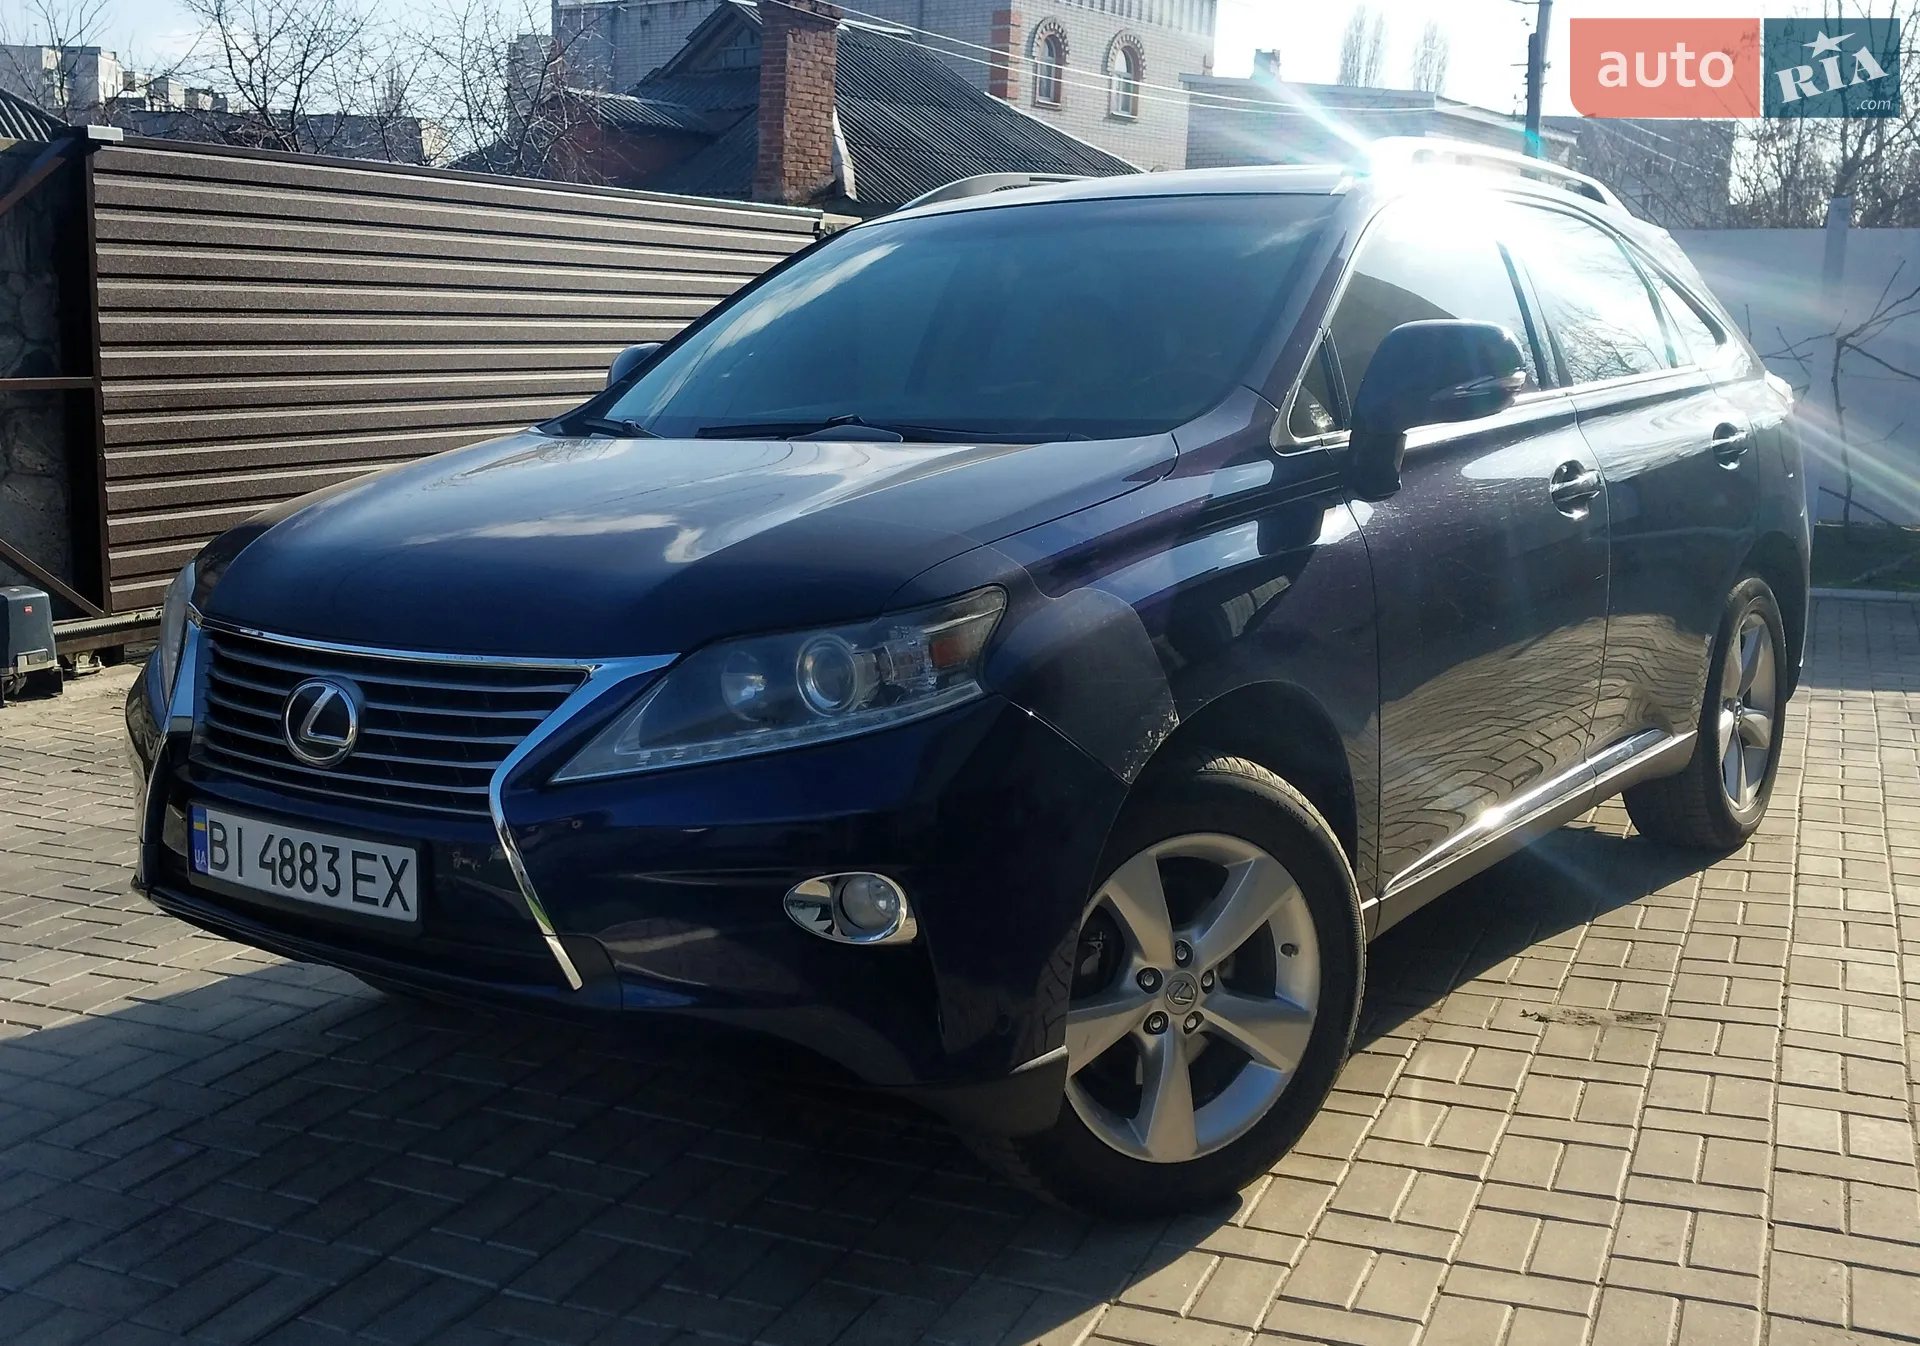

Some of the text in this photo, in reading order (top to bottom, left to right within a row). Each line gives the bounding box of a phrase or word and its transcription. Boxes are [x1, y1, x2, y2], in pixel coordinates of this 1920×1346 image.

[194, 848, 207, 866] UA
[208, 820, 411, 912] BI 4883 EX
